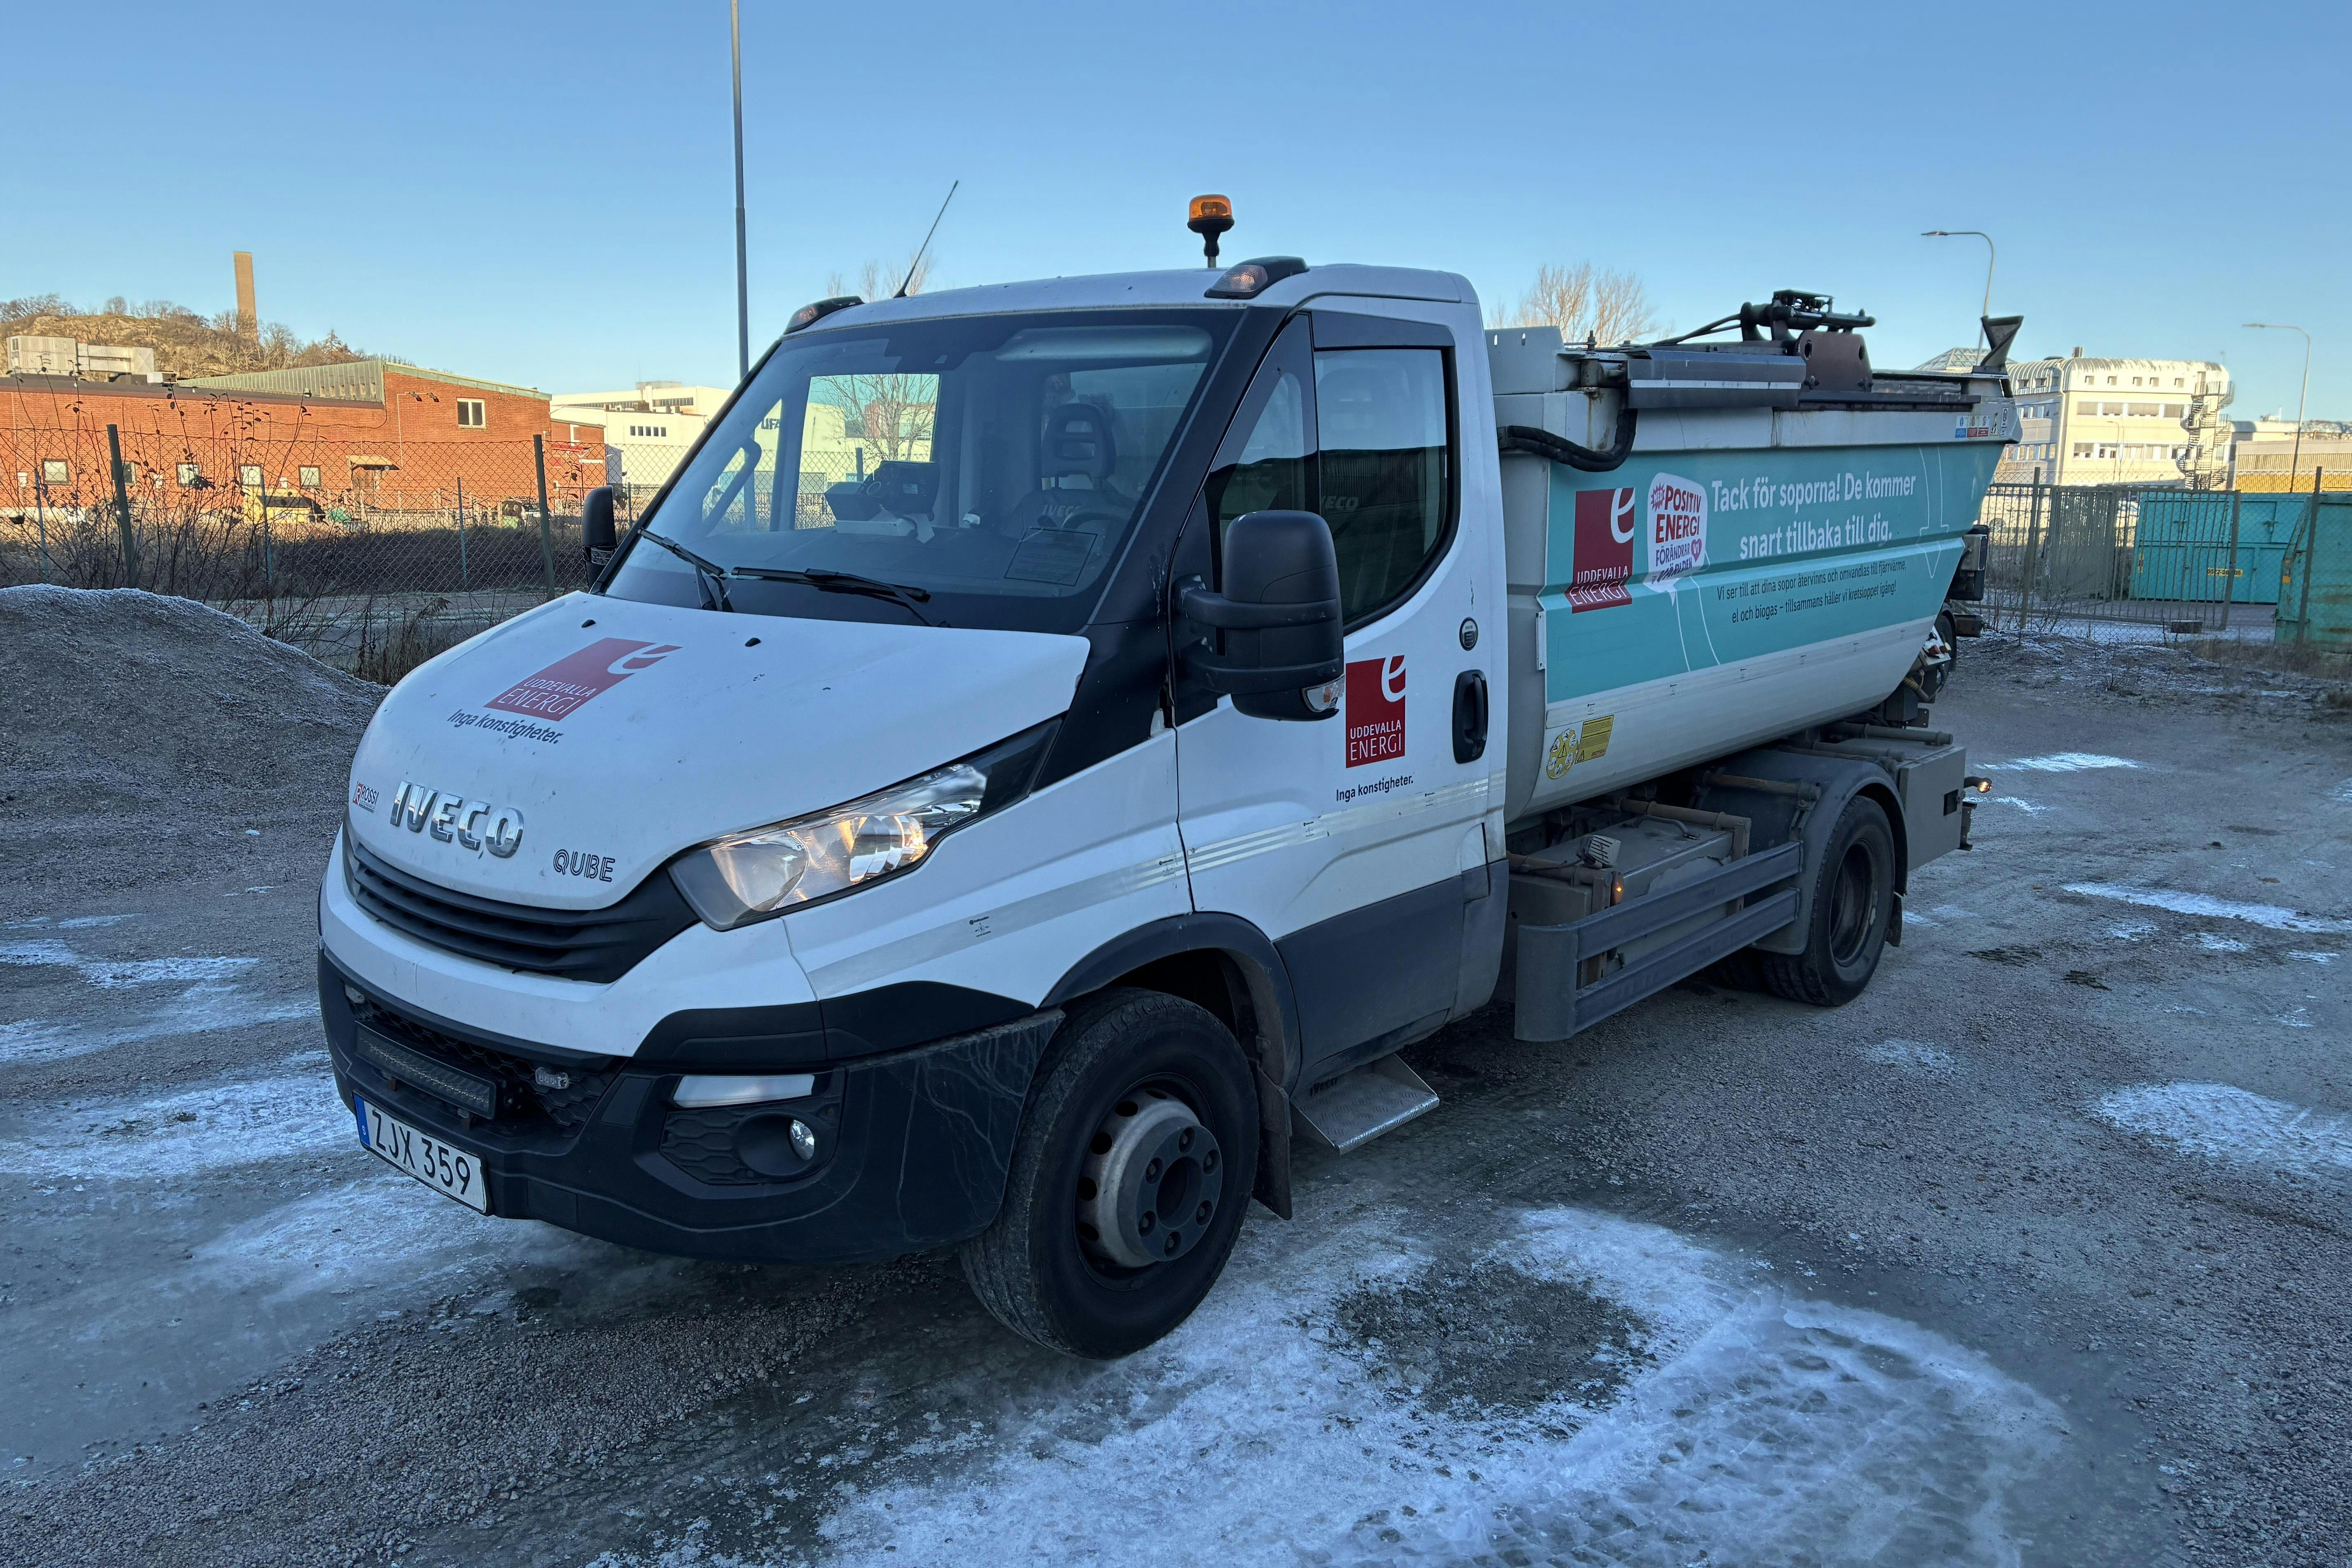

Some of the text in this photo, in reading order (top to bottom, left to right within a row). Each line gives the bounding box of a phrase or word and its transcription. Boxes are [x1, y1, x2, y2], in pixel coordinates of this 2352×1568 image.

[1664, 485, 1702, 513] POSITIV
[1711, 470, 1916, 514] Tack för soporna! De kommer
[1655, 513, 1700, 544] ENERGI
[1739, 512, 1892, 559] snart tillbaka till dig.
[1656, 543, 1691, 567] FÖRÄNDRAR
[1577, 565, 1629, 584] UDDEVALLA
[1717, 586, 1725, 601] Vi
[1727, 588, 1738, 600] ser
[1739, 582, 1749, 597] till
[1750, 583, 1760, 595] att
[1762, 579, 1776, 594] dina
[1778, 578, 1797, 593] sopor
[1798, 572, 1826, 588] återvinns
[1827, 569, 1839, 582] och
[1840, 564, 1870, 580] omvandlas
[1569, 580, 1627, 605] ENERGI
[1732, 608, 1739, 623] el
[1741, 606, 1753, 621] och
[1755, 604, 1778, 620] biogas
[1785, 596, 1823, 613] tillsammans
[1825, 590, 1841, 606] håller
[1842, 589, 1848, 602] vi
[1848, 584, 1879, 601] kretsloppet
[1880, 580, 1897, 597] igång!
[497, 688, 581, 714] ENERGI
[524, 678, 597, 698] UDDEVALLA
[447, 709, 564, 744] Inga konstigheter.
[1350, 719, 1401, 740] UDDEVALLA
[1350, 733, 1401, 761] ENERGI
[361, 785, 379, 805] ROSSI
[1336, 775, 1414, 803] Inga konstigheter.
[390, 781, 525, 859] IVECO
[553, 849, 616, 882] QUBE
[362, 1110, 471, 1195] S ZJX 359
